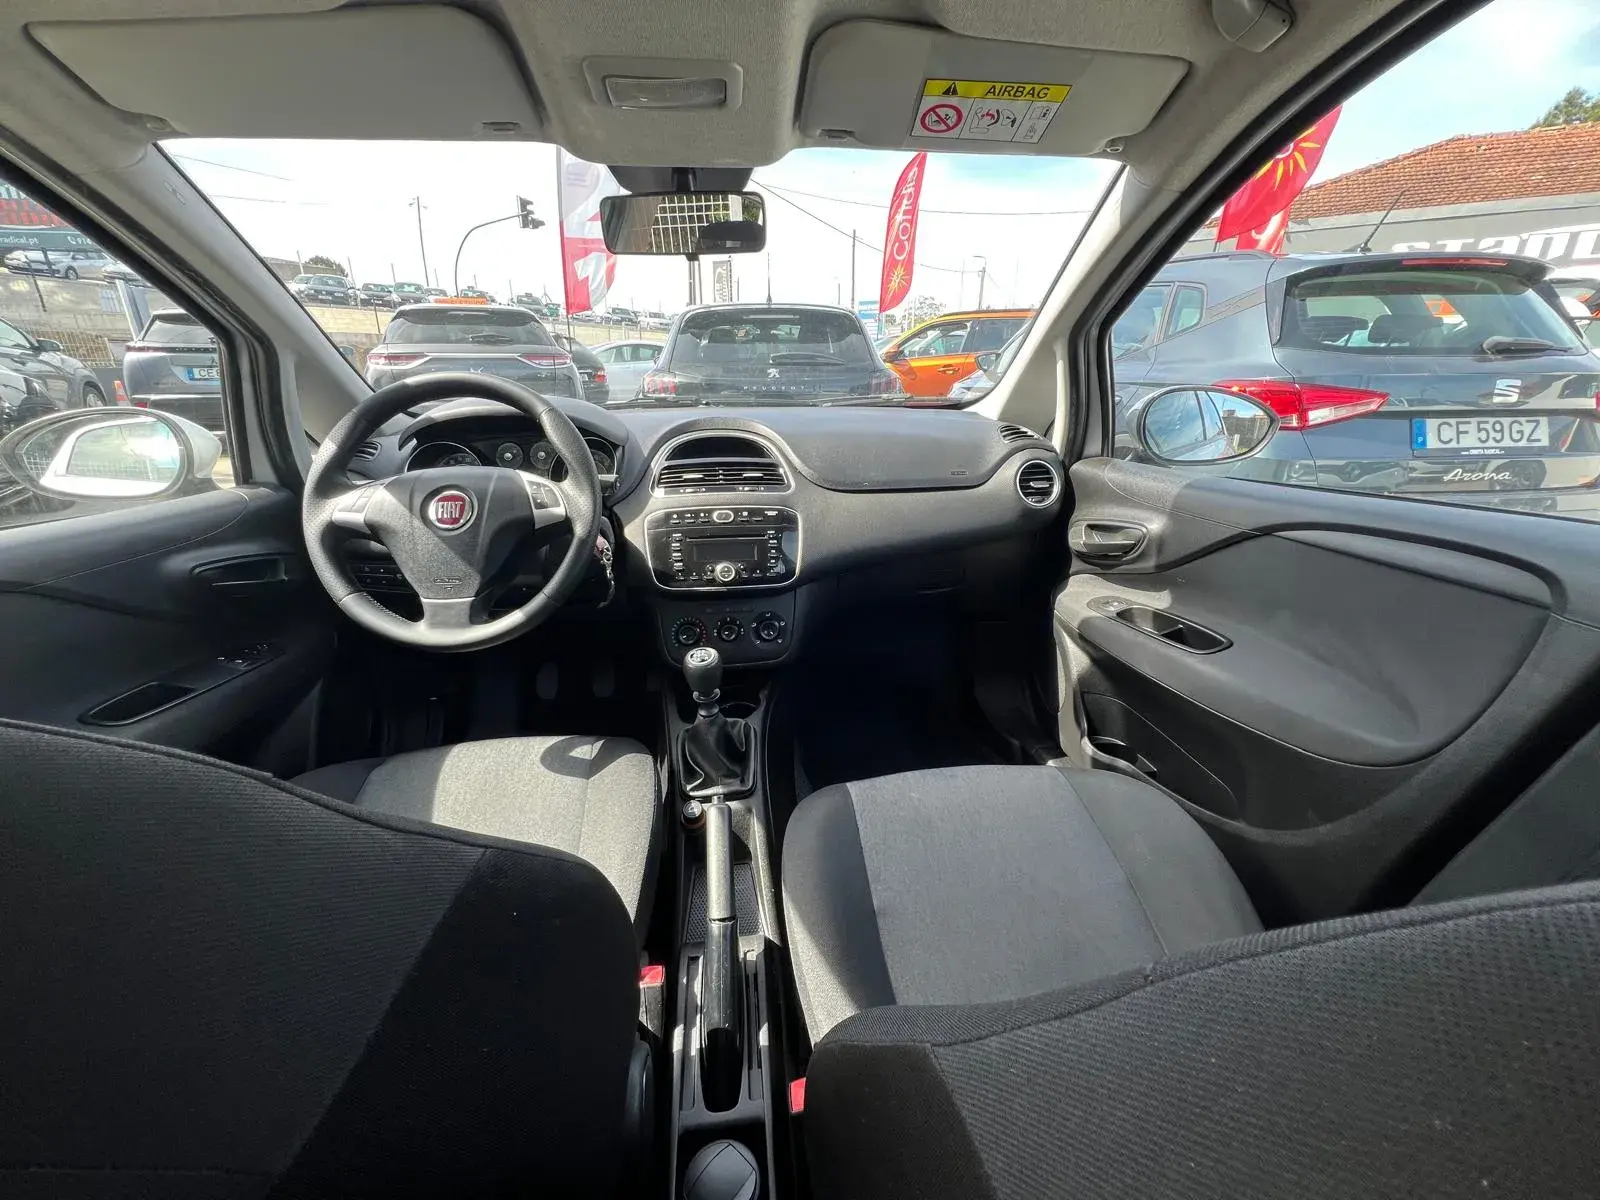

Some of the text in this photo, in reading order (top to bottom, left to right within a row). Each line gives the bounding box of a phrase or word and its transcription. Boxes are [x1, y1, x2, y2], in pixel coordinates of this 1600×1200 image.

[985, 84, 1051, 99] AIRBAG
[1437, 419, 1542, 444] CF 59 GZ
[1442, 468, 1512, 481] Arona
[437, 501, 463, 519] FIAT
